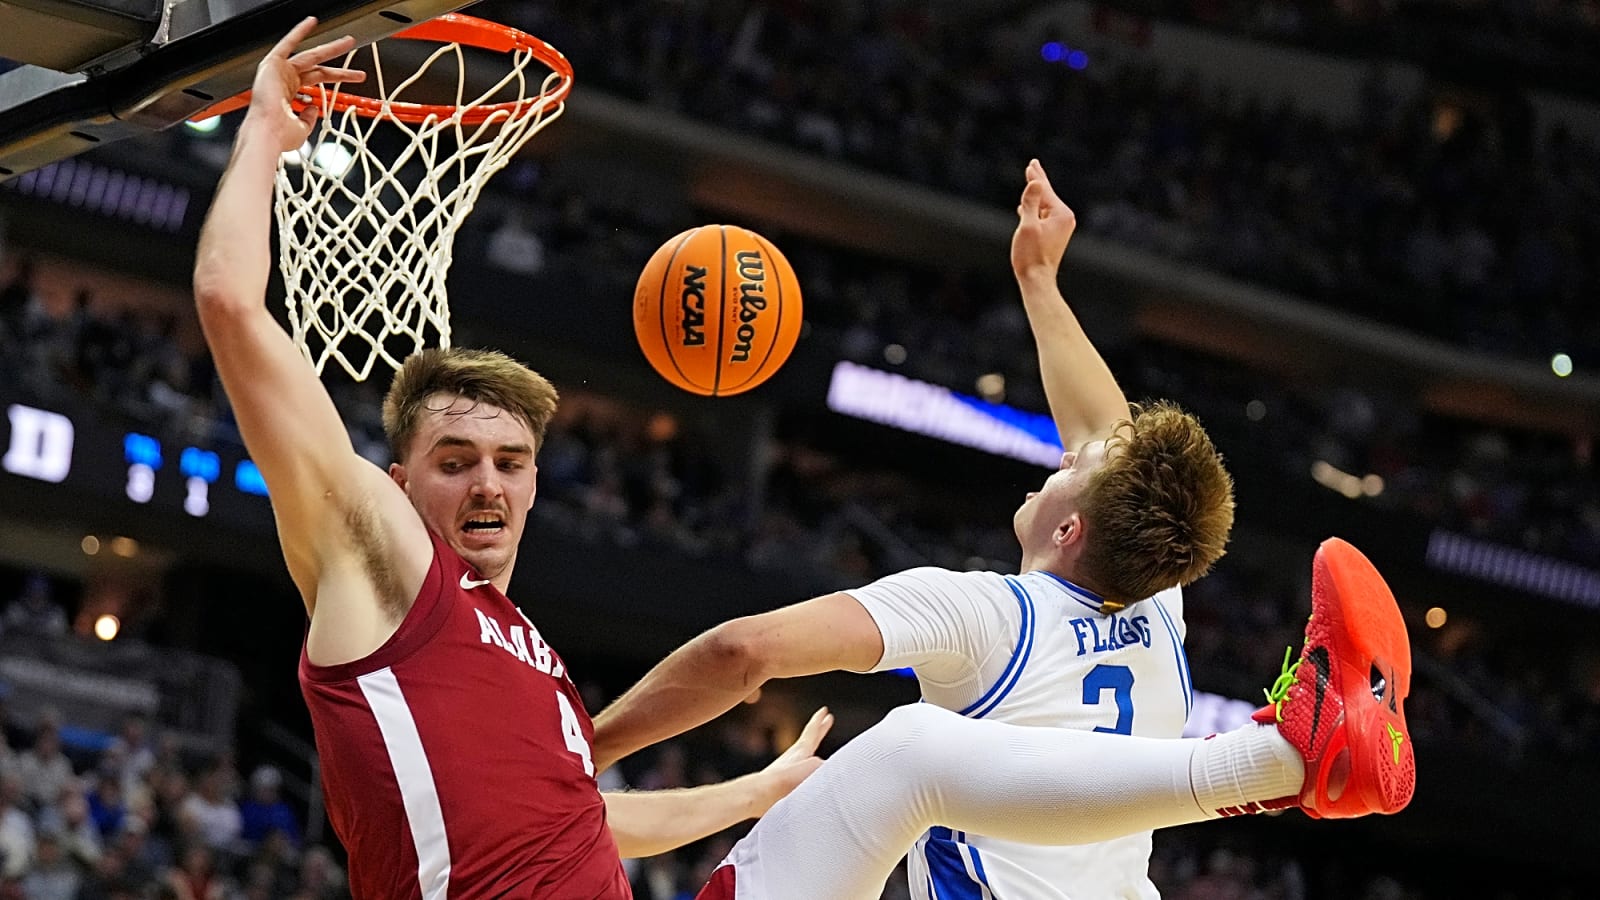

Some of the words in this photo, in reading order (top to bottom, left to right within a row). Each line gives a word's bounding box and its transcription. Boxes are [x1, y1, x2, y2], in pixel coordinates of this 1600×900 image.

[681, 264, 708, 347] NCAA
[729, 250, 768, 365] Wilson
[474, 607, 568, 681] ALAB
[1068, 613, 1152, 657] FLAGG
[555, 689, 595, 778] 4
